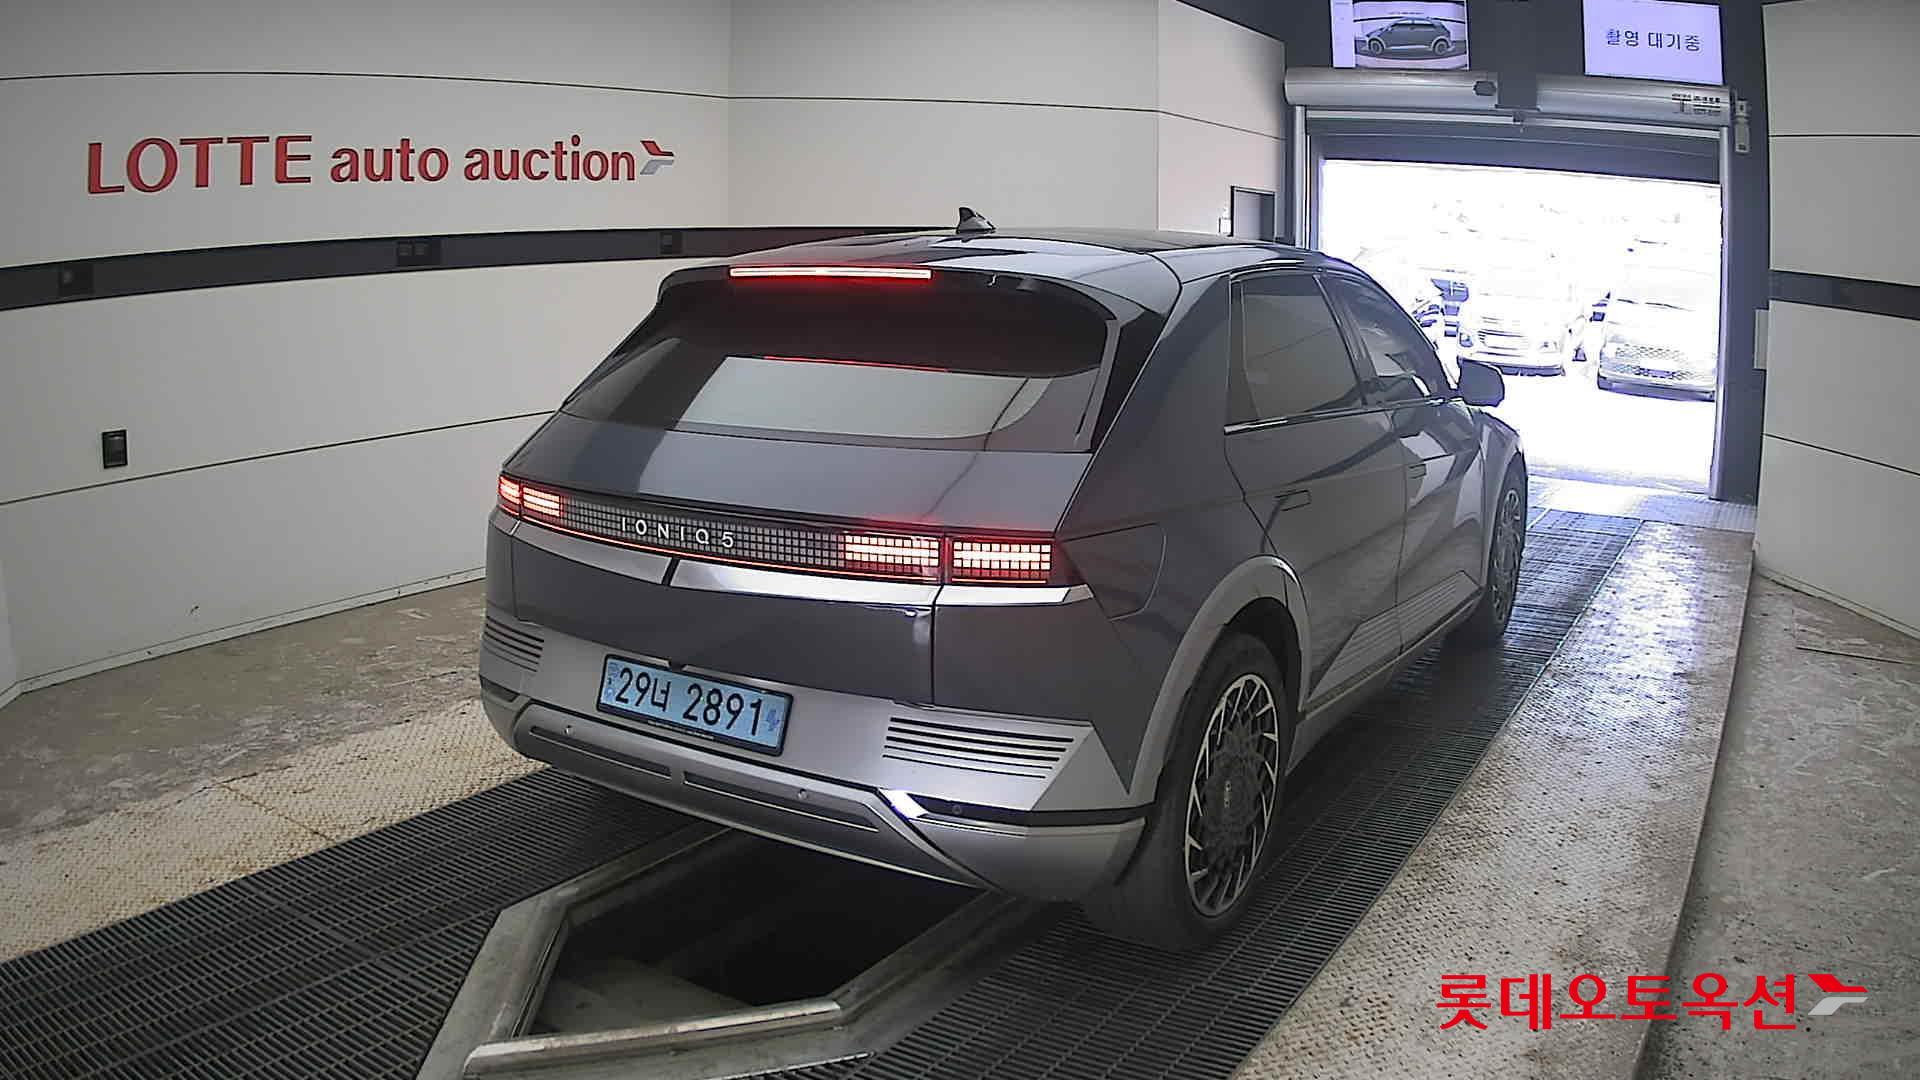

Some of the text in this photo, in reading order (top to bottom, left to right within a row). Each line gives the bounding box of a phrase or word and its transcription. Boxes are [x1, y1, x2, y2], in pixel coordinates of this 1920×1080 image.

[1648, 32, 1701, 52] 대기중
[87, 134, 636, 194] LOTTE auto auction
[621, 516, 734, 548] IONIQ 5
[615, 667, 762, 736] 29너 2891
